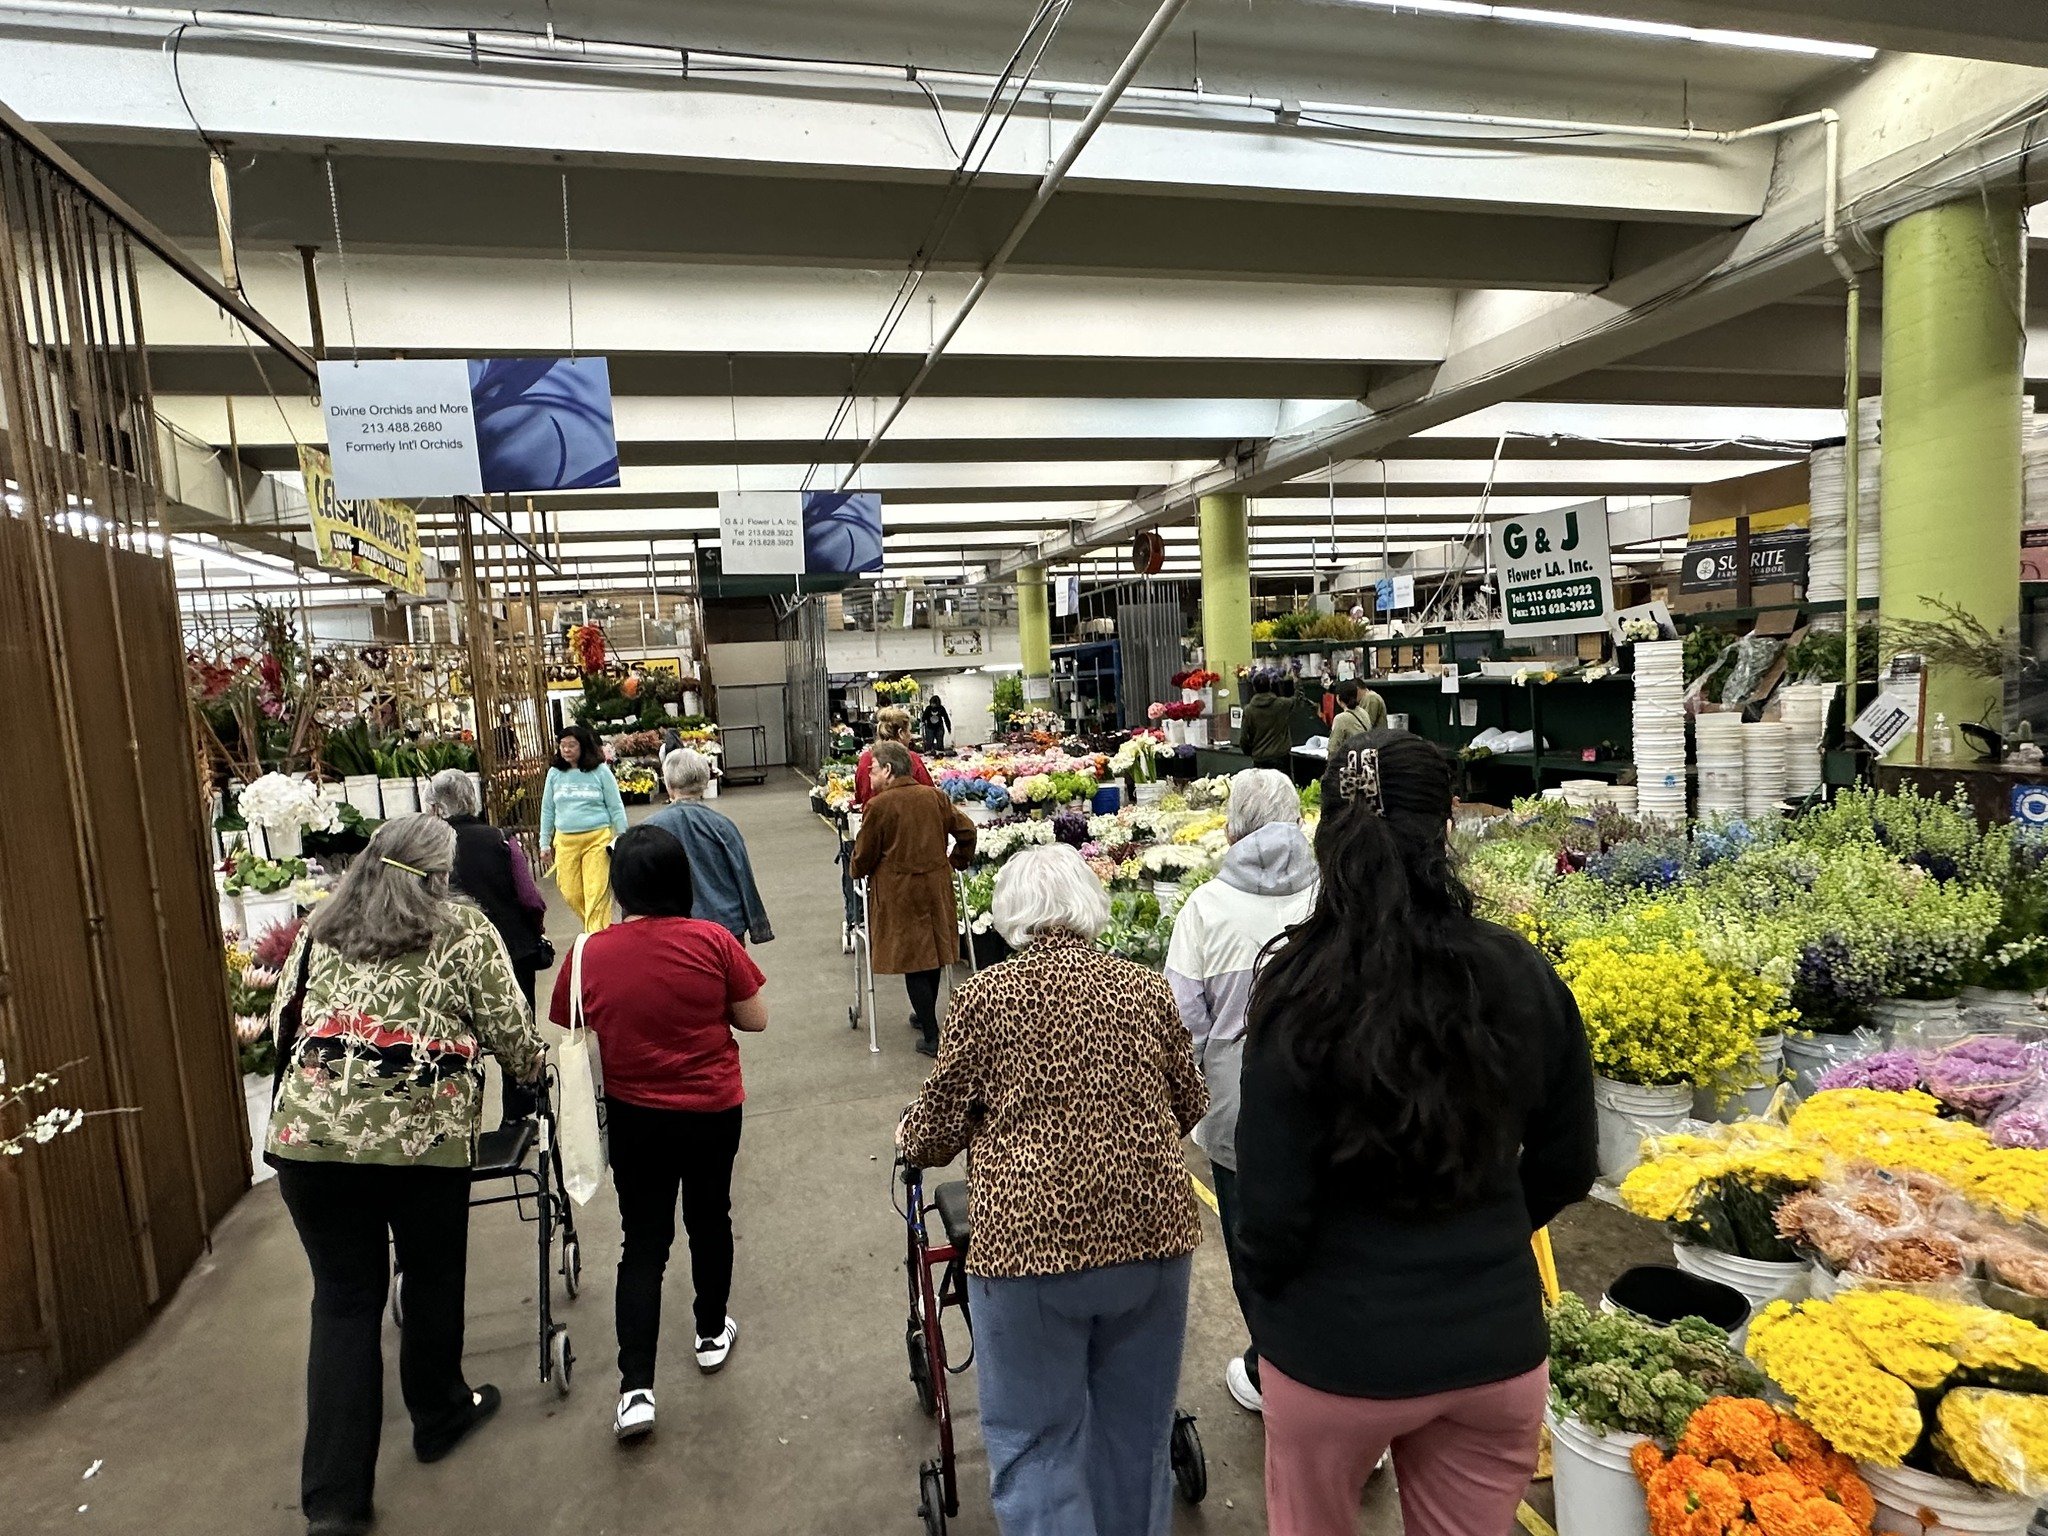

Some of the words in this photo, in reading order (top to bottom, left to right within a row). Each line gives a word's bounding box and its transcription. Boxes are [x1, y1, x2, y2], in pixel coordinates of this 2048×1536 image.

[331, 405, 366, 416] Divine
[369, 404, 413, 415] Orchids
[416, 404, 437, 415] and
[439, 403, 469, 415] More
[362, 421, 443, 434] 213.488.2680
[346, 440, 396, 453] Formerly
[399, 439, 417, 451] Int'l
[420, 439, 463, 450] Orchids
[1503, 522, 1528, 559] G
[1535, 527, 1552, 554] &
[1560, 510, 1580, 551] J
[1718, 549, 1785, 570] SURITE
[1507, 567, 1542, 583] Flower
[1568, 558, 1593, 574] Inc.
[1511, 593, 1526, 604] Tel:
[1526, 590, 1544, 602] 213
[1545, 584, 1593, 600] 628-3922
[1512, 608, 1529, 618] Fax:
[1529, 605, 1547, 617] 213
[1548, 599, 1596, 615] 628-3923
